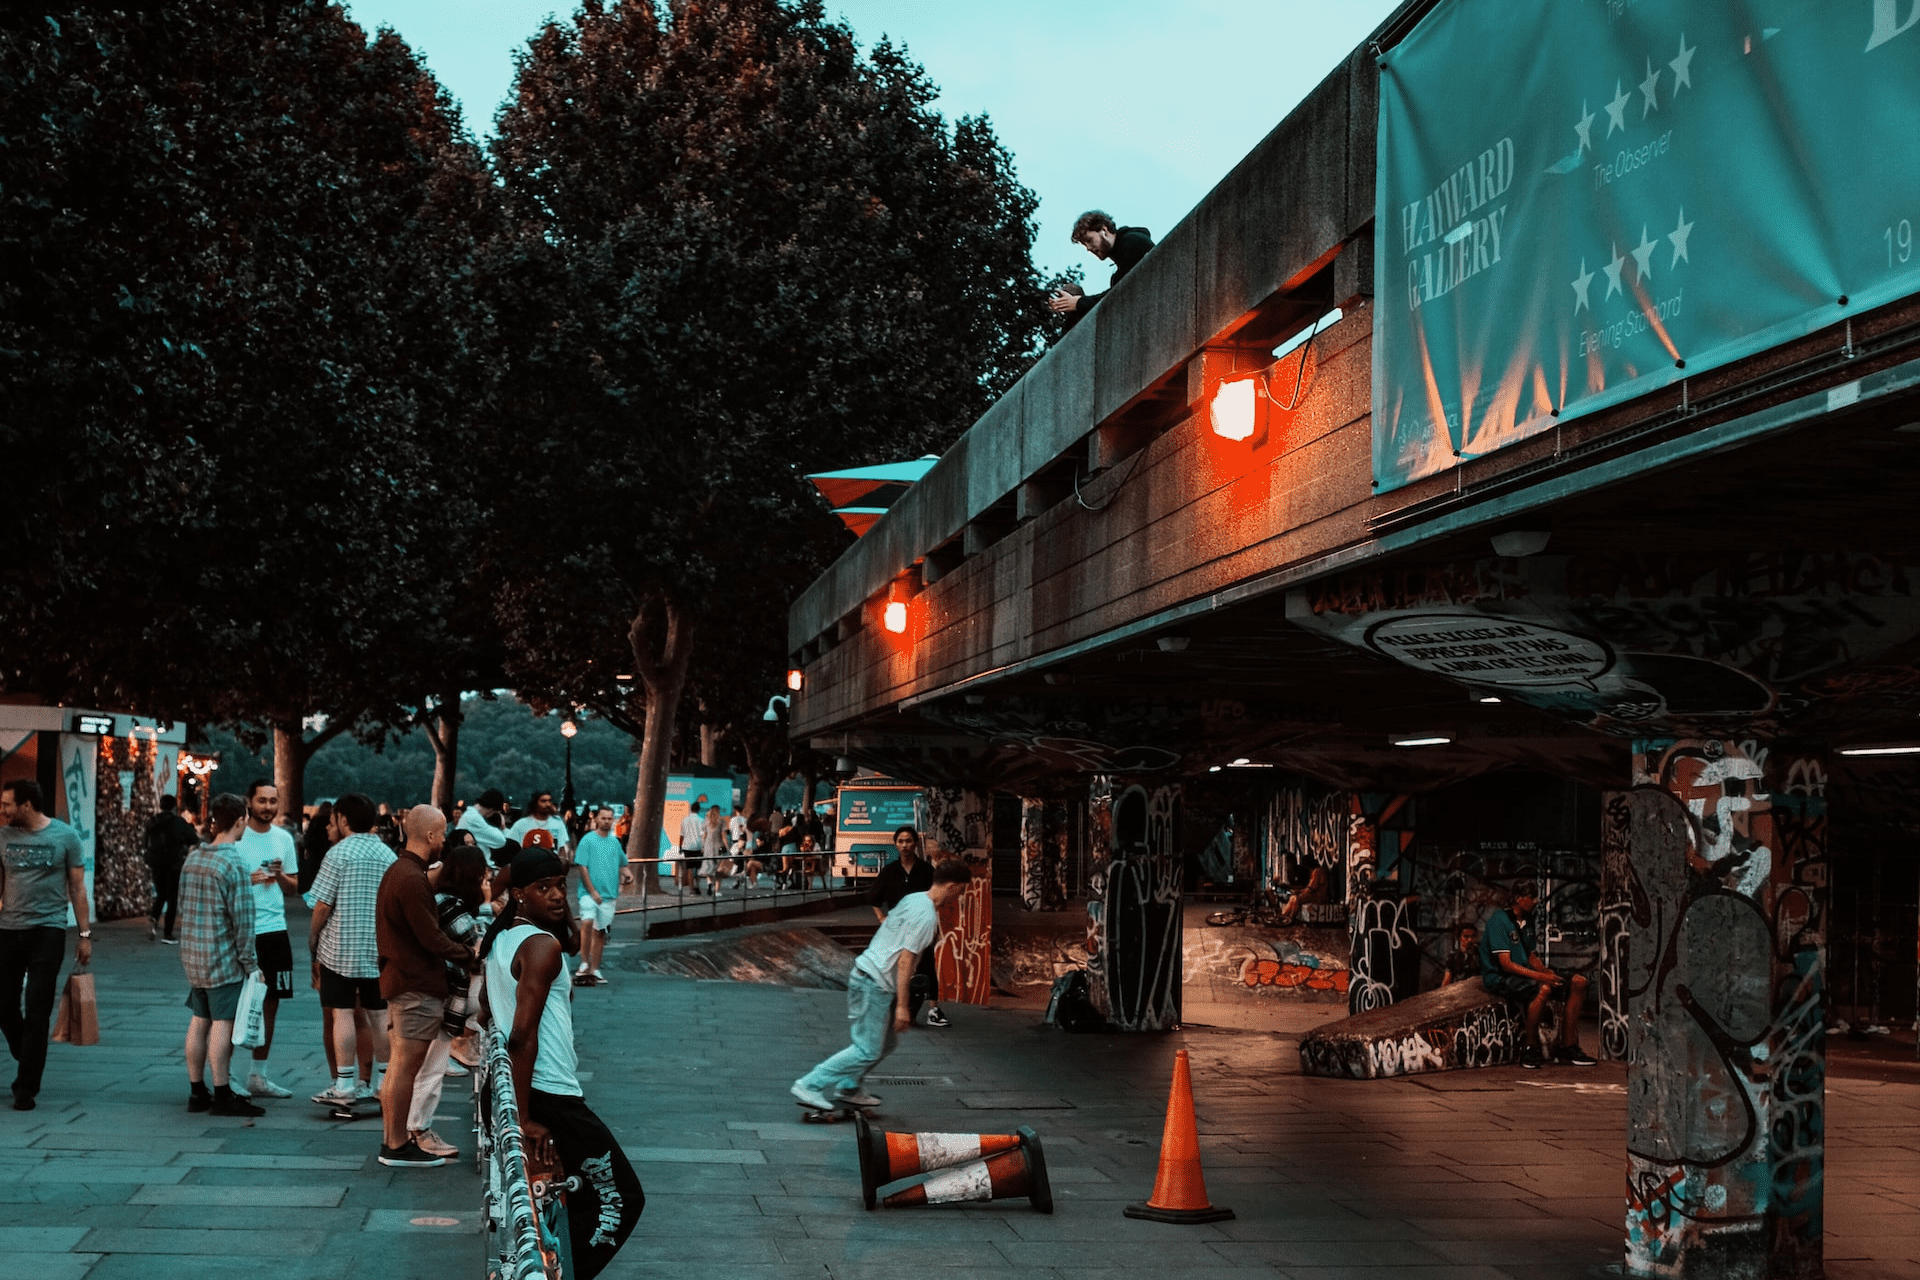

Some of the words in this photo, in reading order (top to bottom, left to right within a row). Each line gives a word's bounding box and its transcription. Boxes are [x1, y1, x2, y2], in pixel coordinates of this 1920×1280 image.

[1593, 164, 1613, 191] The
[1615, 130, 1673, 178] Observer
[1407, 204, 1507, 312] GALLERY
[1579, 319, 1625, 358] Evening
[1376, 632, 1445, 647] PLEASE
[1433, 628, 1507, 644] EXCUSE
[1496, 625, 1535, 639] MY
[1502, 640, 1530, 654] IT
[1522, 637, 1570, 653] HAS
[532, 833, 542, 845] S
